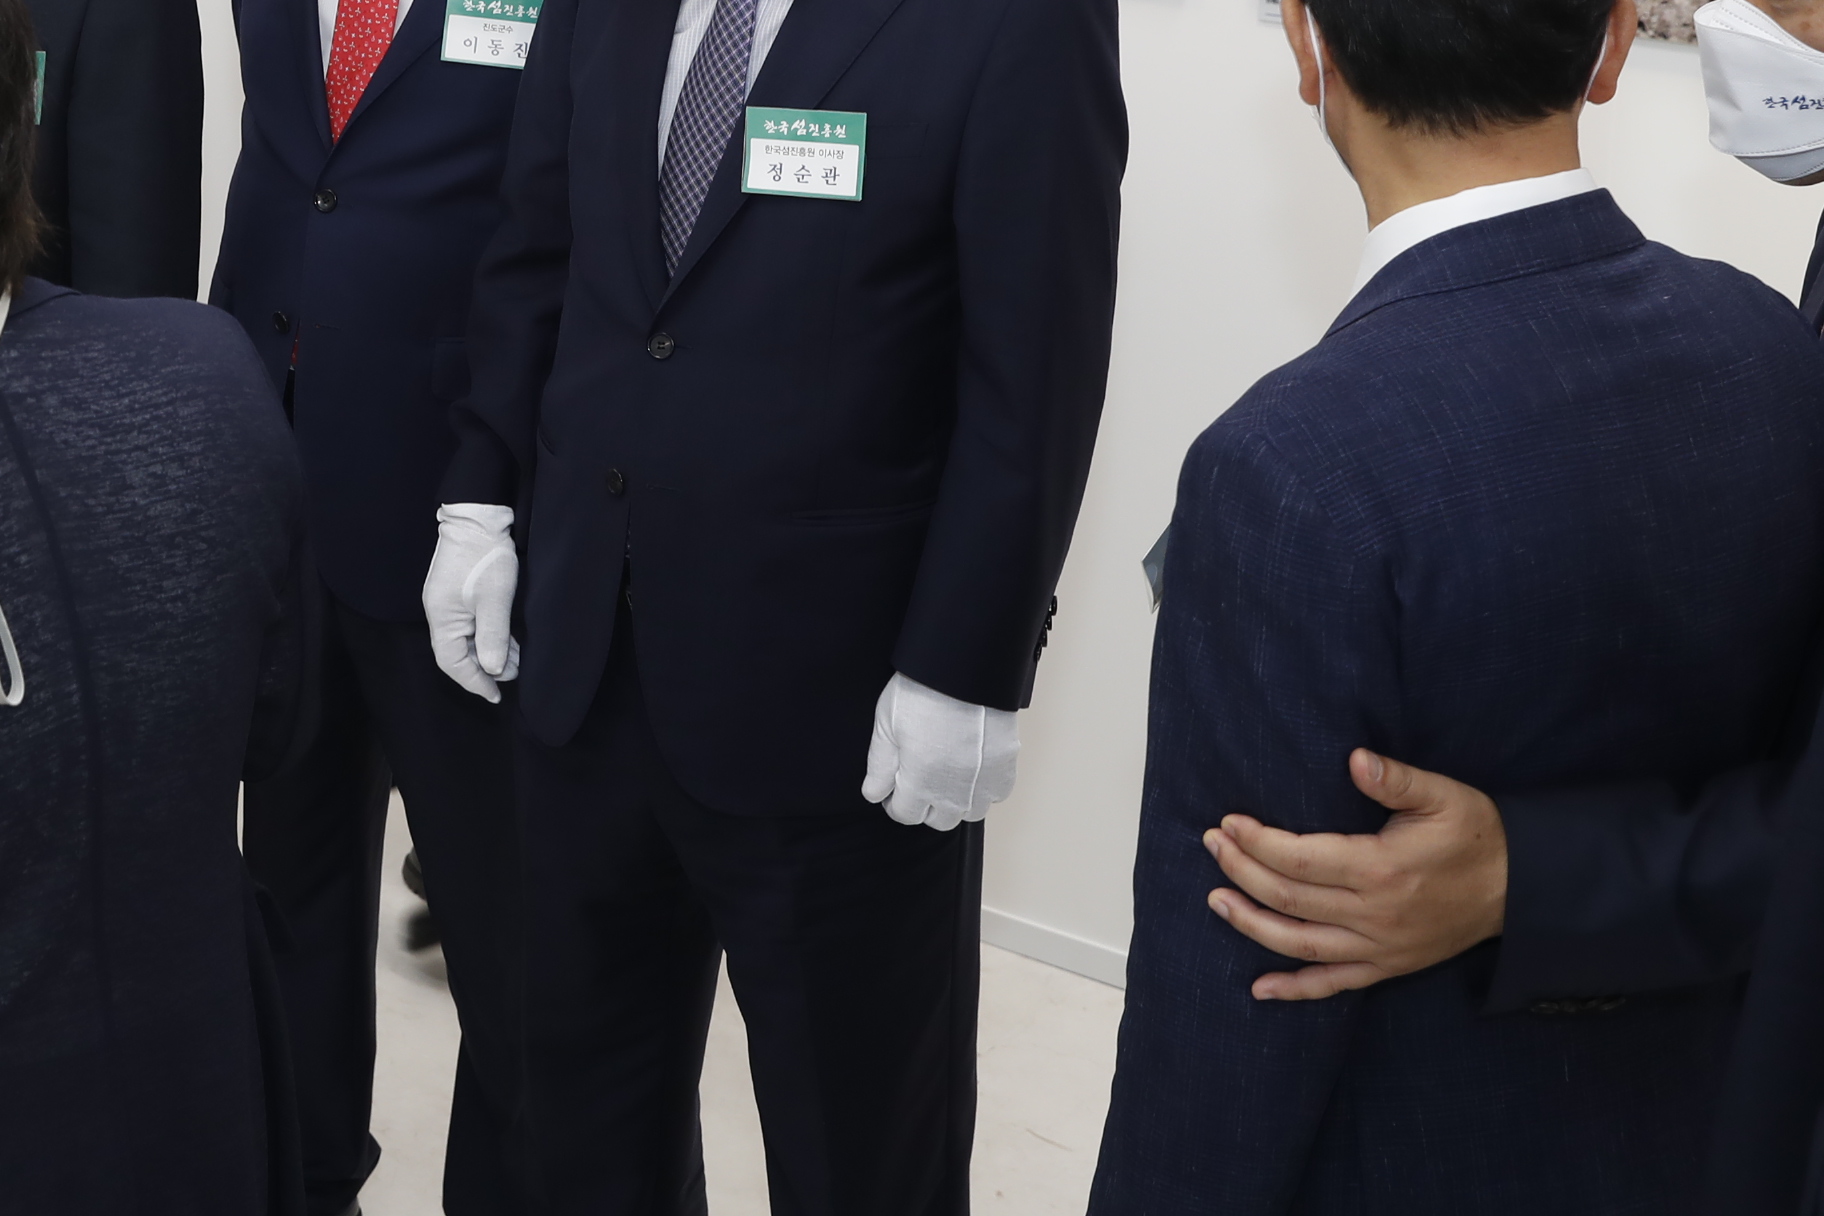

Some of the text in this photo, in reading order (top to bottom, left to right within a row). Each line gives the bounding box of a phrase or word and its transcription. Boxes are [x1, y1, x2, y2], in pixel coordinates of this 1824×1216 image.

[483, 23, 514, 34] 진도군수
[1762, 95, 1824, 110] 한국섬진
[764, 119, 847, 138] 한국섬진흥원
[765, 145, 845, 160] 한국섬진흥원 이사장
